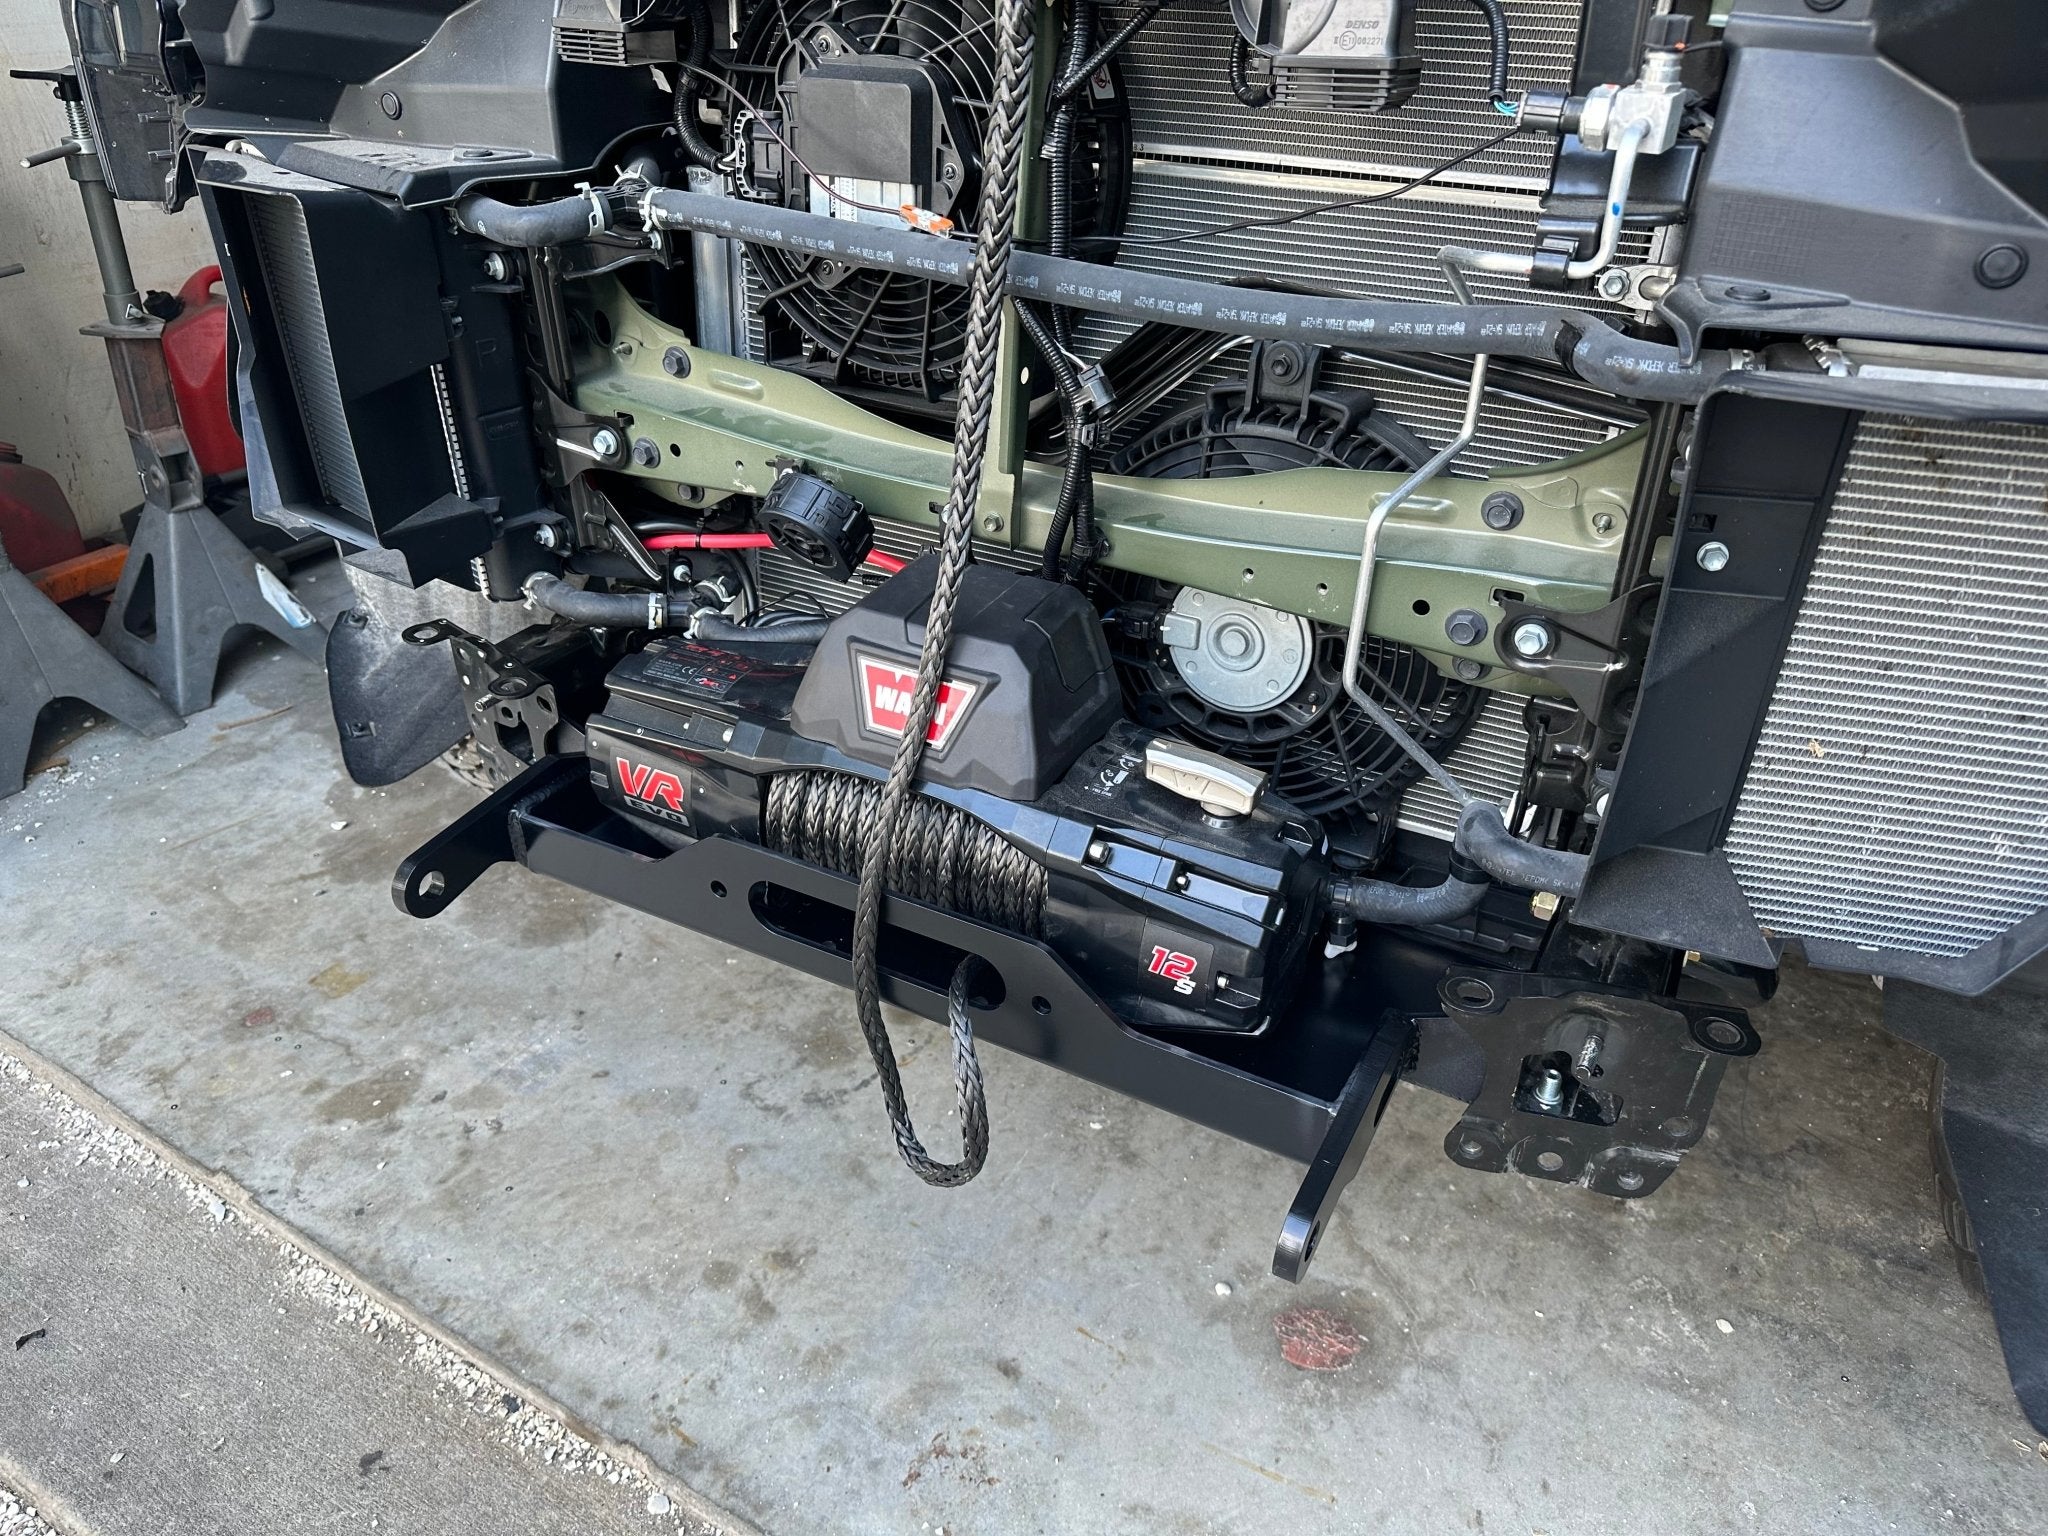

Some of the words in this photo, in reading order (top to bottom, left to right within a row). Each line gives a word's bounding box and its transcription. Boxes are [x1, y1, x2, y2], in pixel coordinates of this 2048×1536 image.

[1345, 19, 1379, 30] DENSO
[875, 684, 947, 726] WAN
[616, 756, 684, 812] VR
[629, 799, 684, 824] EVO
[1148, 945, 1198, 982] 12
